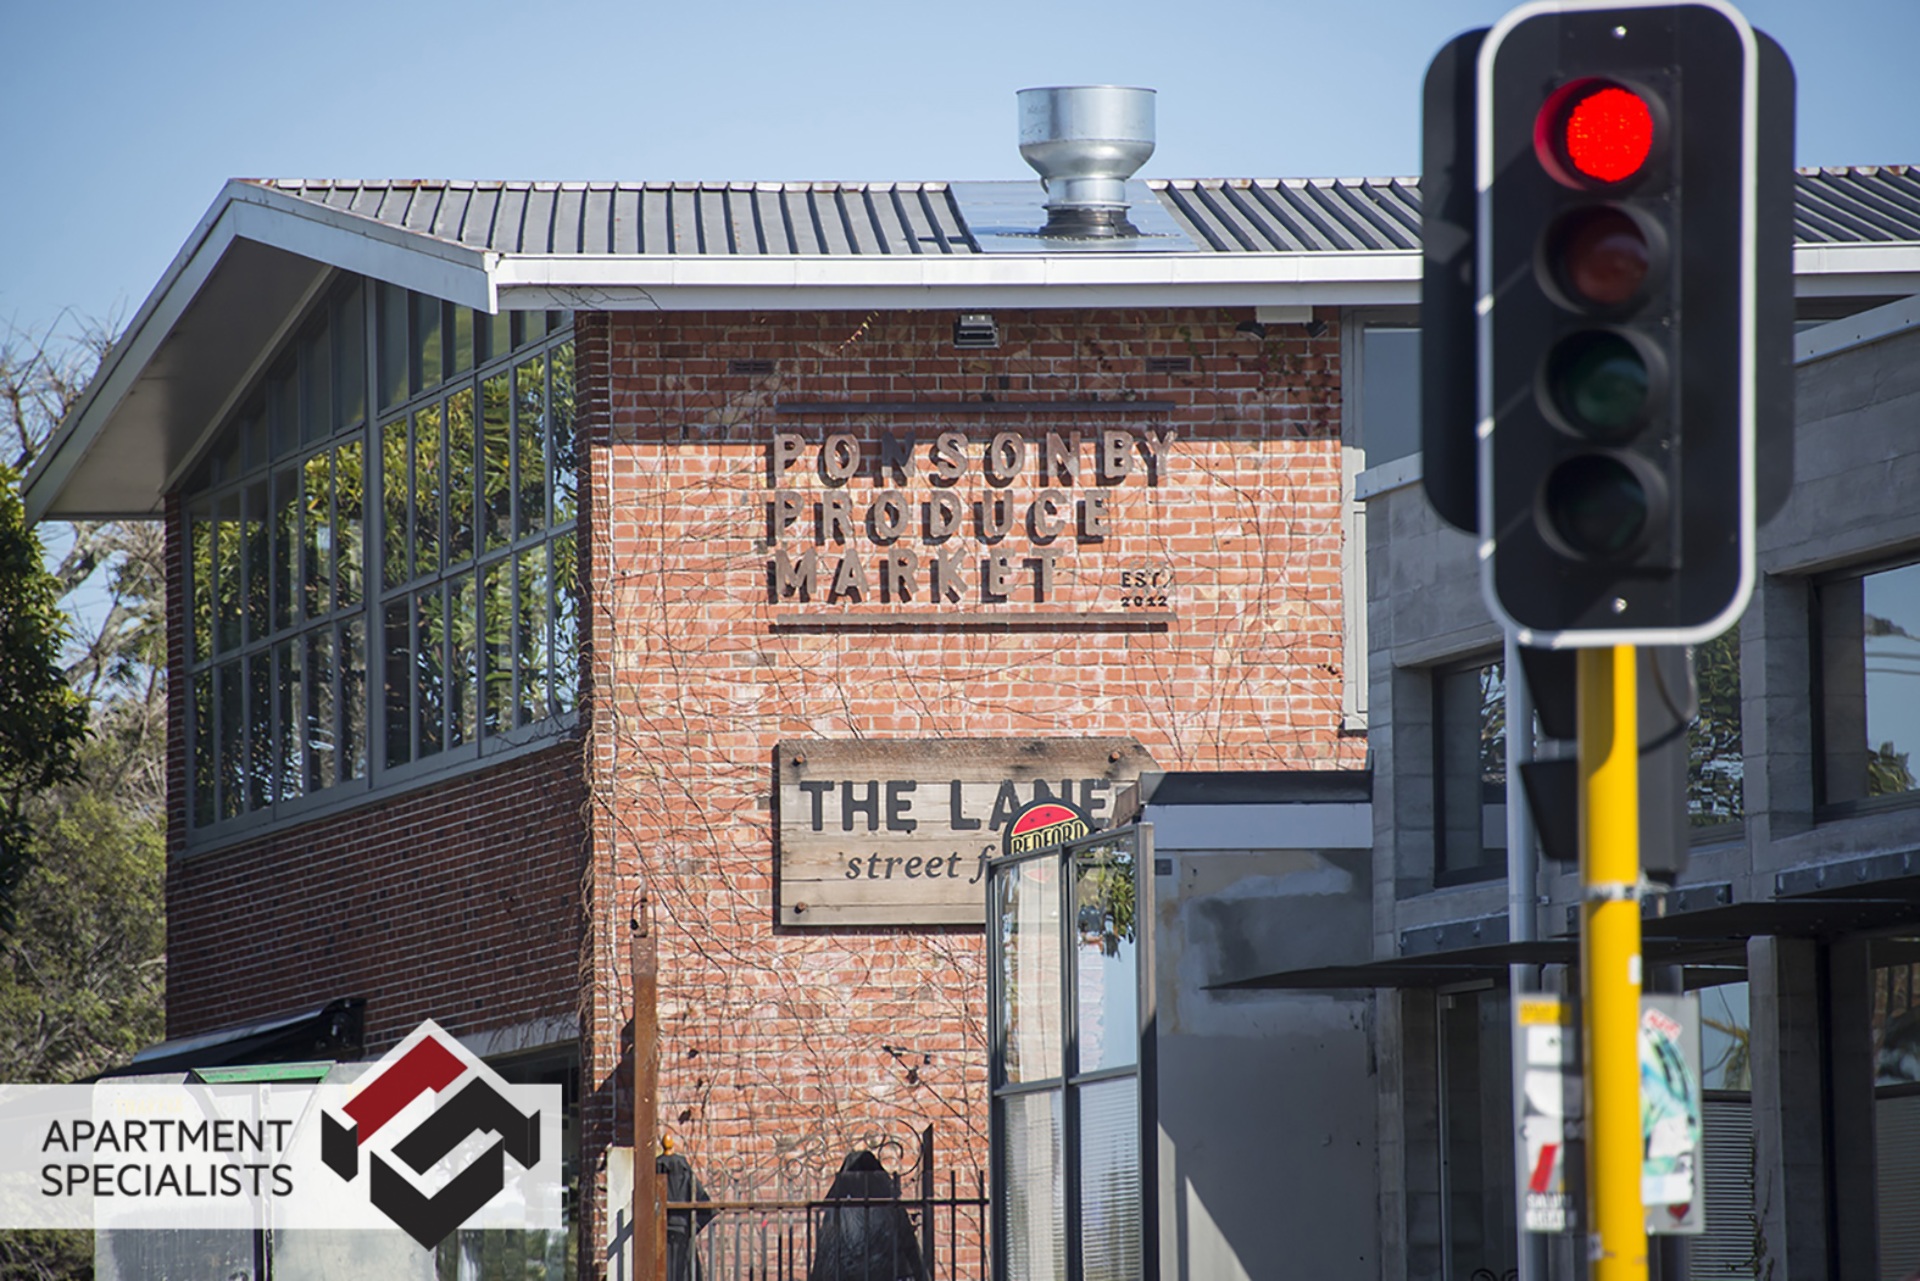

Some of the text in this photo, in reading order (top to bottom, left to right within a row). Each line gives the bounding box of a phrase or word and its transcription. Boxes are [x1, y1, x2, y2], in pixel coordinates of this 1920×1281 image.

[773, 431, 1178, 479] PONSONBY
[773, 489, 1111, 537] PRODUCE
[774, 547, 1064, 596] MARKET
[1120, 595, 1168, 607] 2012
[799, 779, 917, 832] THE
[845, 851, 962, 880] street
